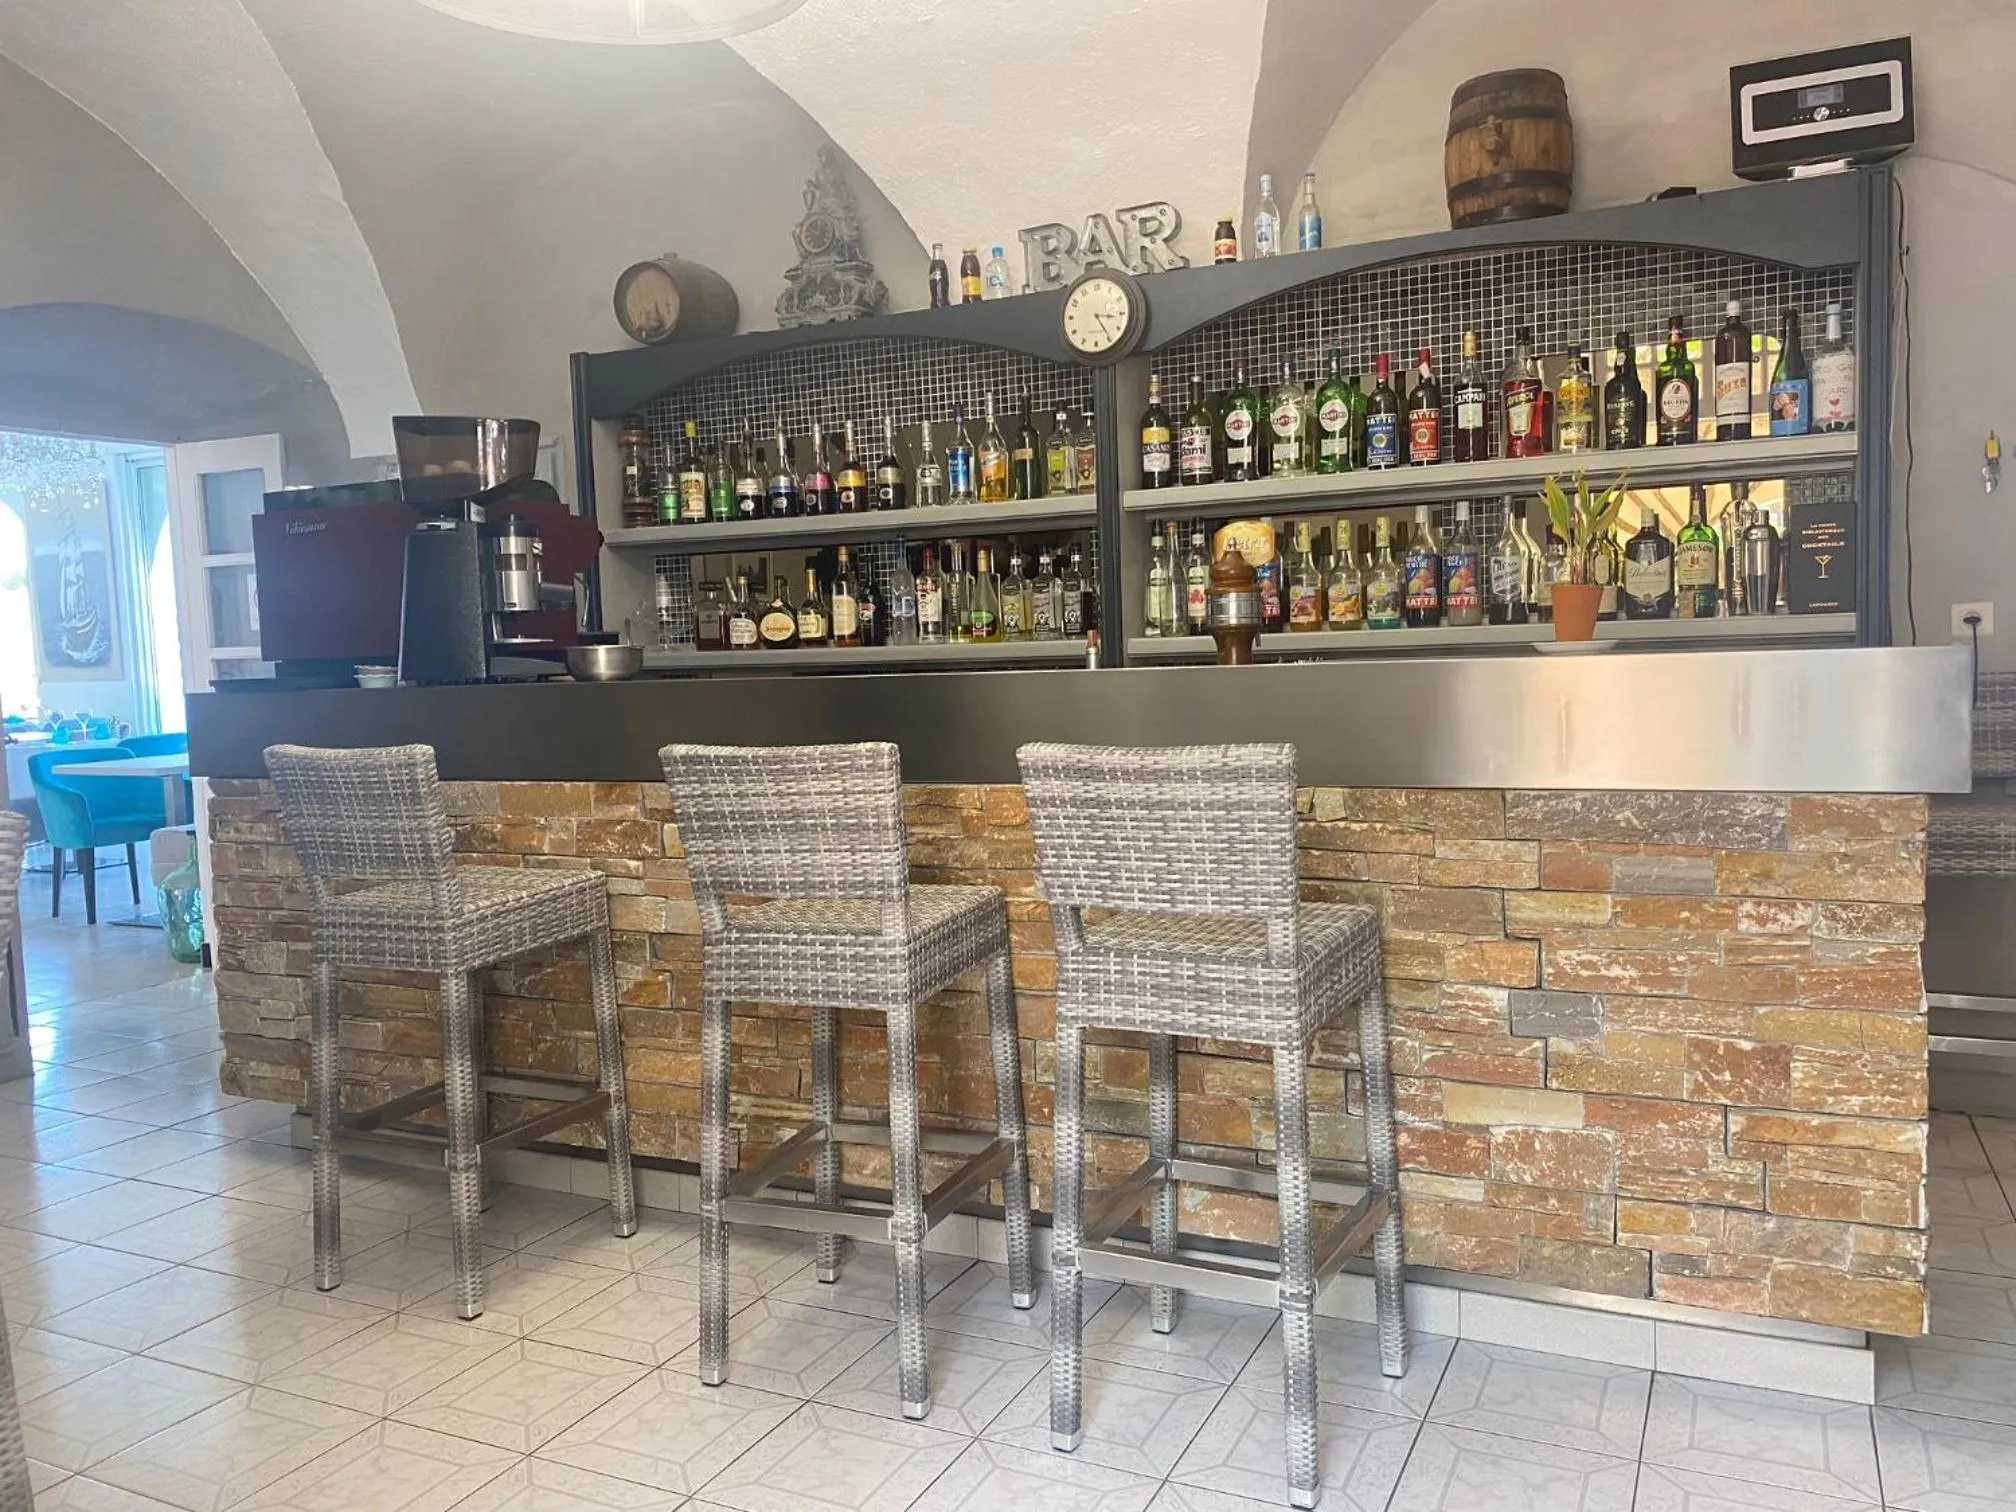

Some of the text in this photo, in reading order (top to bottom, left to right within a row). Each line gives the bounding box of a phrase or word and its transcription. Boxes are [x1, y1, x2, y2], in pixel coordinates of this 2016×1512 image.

[1018, 201, 1190, 295] BAR
[1716, 377, 1747, 400] Suze
[1454, 392, 1486, 404] CAMPARI
[1678, 542, 1714, 554] JAMESON
